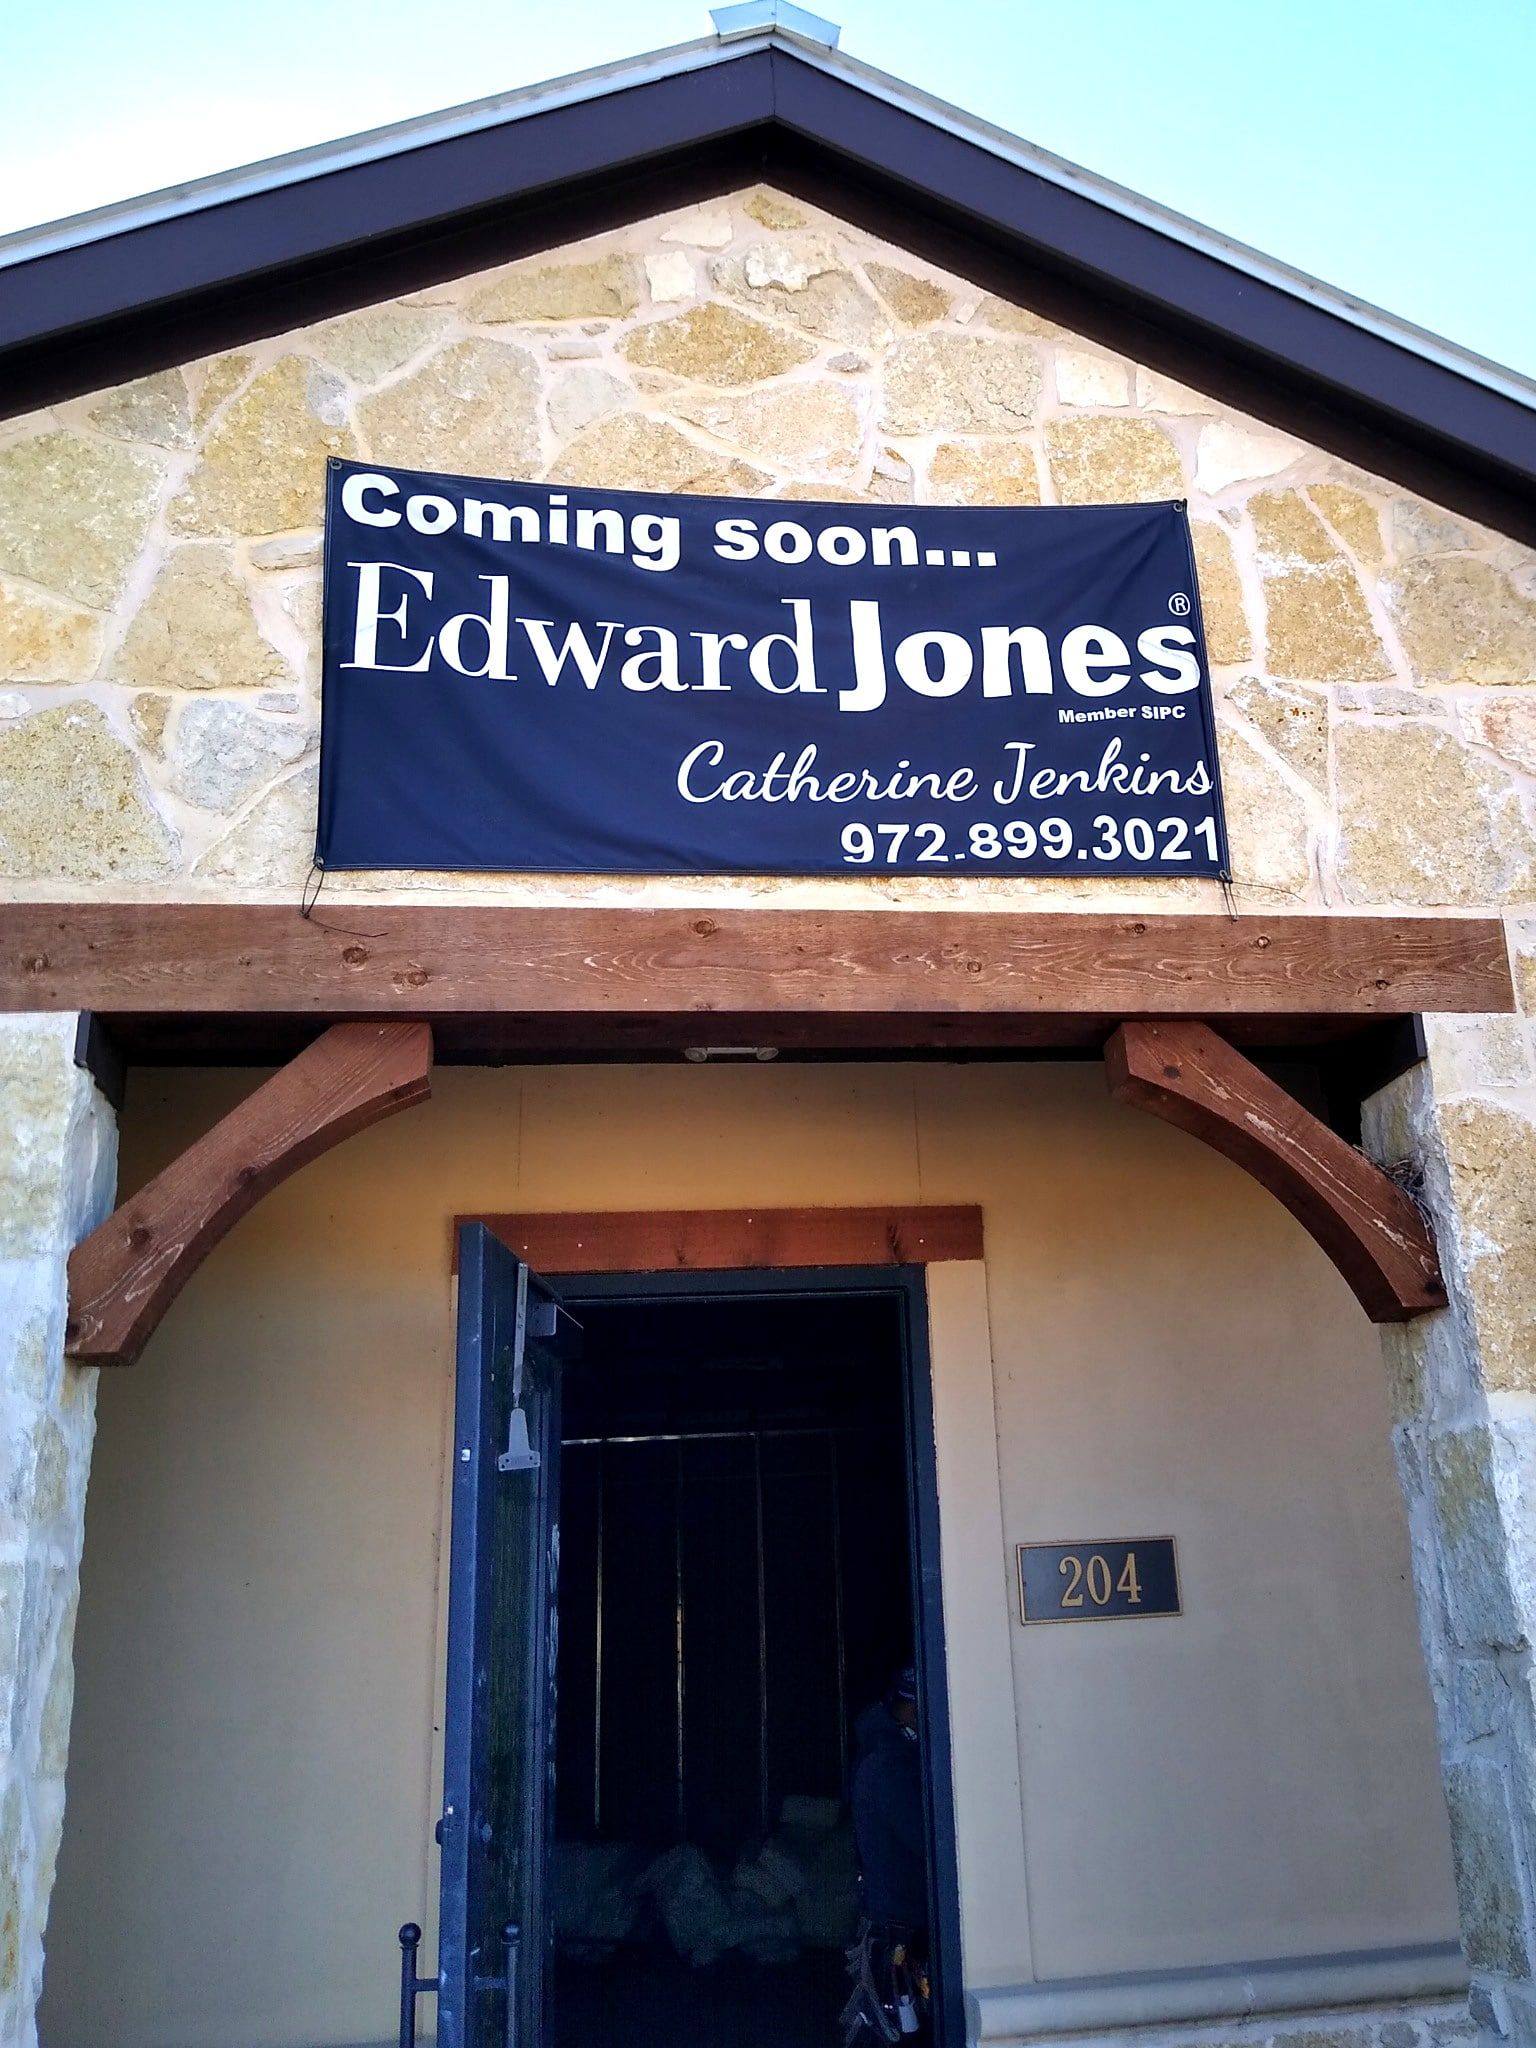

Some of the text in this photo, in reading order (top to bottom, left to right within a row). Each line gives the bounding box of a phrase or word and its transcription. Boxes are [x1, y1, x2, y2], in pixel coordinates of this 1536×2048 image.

[340, 472, 998, 572] Coming soon...
[339, 561, 1201, 712] Edward Jones
[1058, 705, 1186, 723] Member SIPC
[676, 736, 1214, 805] Catherine Jenkins
[840, 814, 1219, 864] 972.899.3021
[1059, 1552, 1142, 1608] 204
